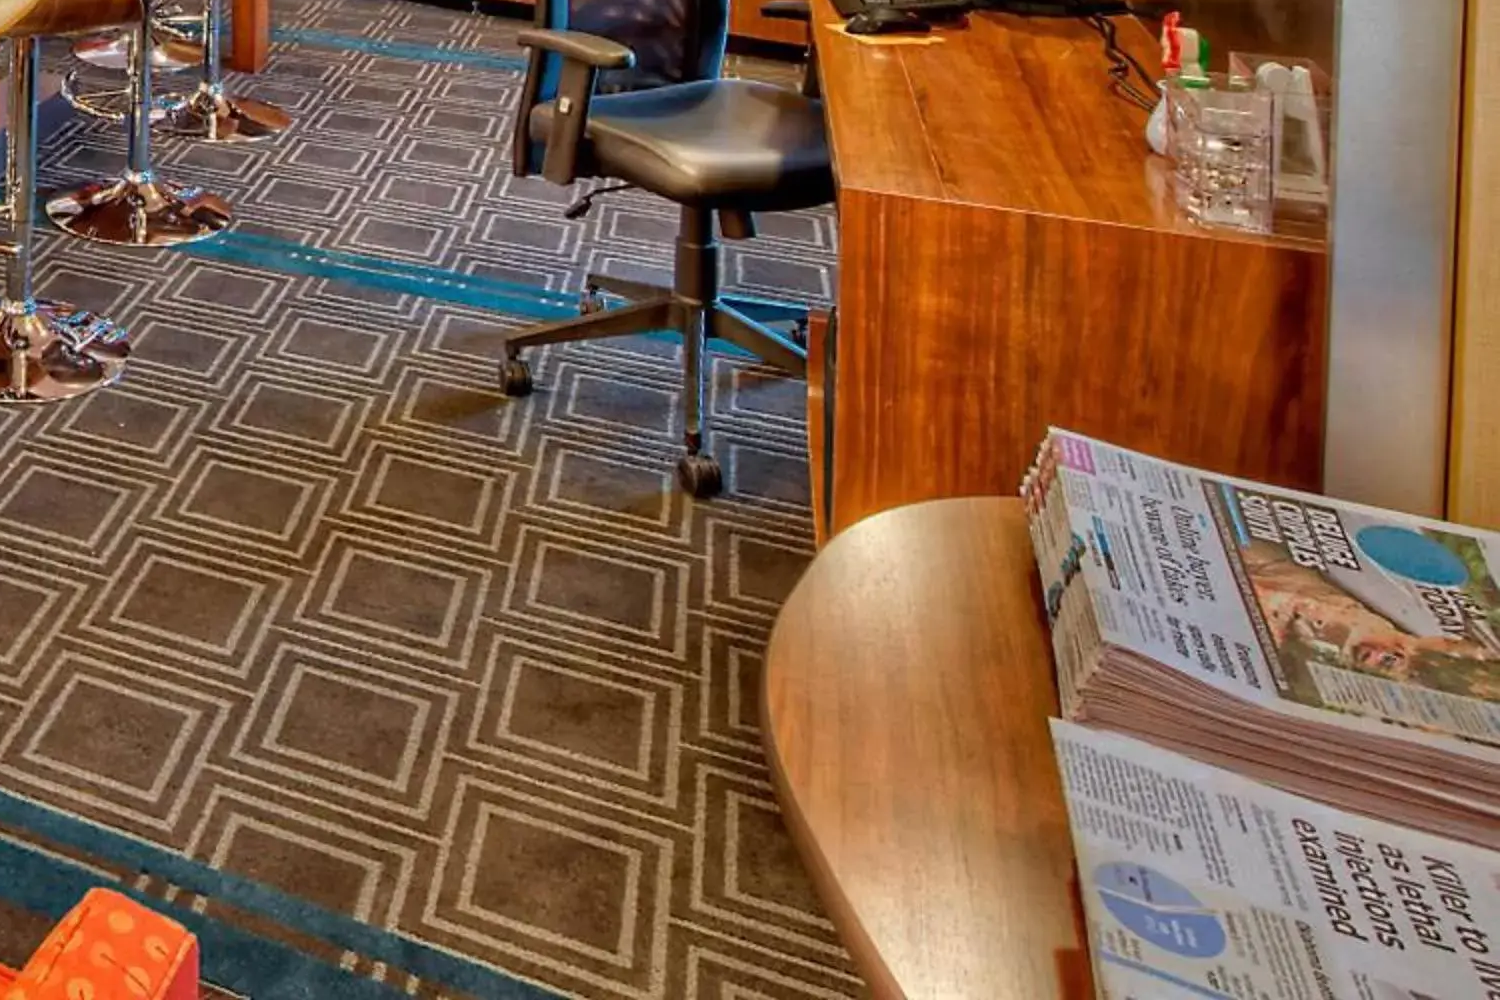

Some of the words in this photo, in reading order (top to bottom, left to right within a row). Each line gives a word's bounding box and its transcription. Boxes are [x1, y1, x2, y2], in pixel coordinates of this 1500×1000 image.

[1140, 494, 1170, 548] beware
[1160, 562, 1189, 606] fakes
[1172, 504, 1202, 553] Online
[1241, 496, 1284, 543] SOUTH
[1273, 502, 1327, 573] CRIPPLES
[1305, 507, 1359, 571] DELUGE
[1414, 584, 1468, 641] TODAY
[1291, 818, 1369, 942] examined
[1333, 830, 1405, 950] injections
[1377, 843, 1411, 873] as
[1392, 875, 1457, 953] lethal
[1422, 855, 1474, 922] Killer
[1455, 926, 1489, 954] to
